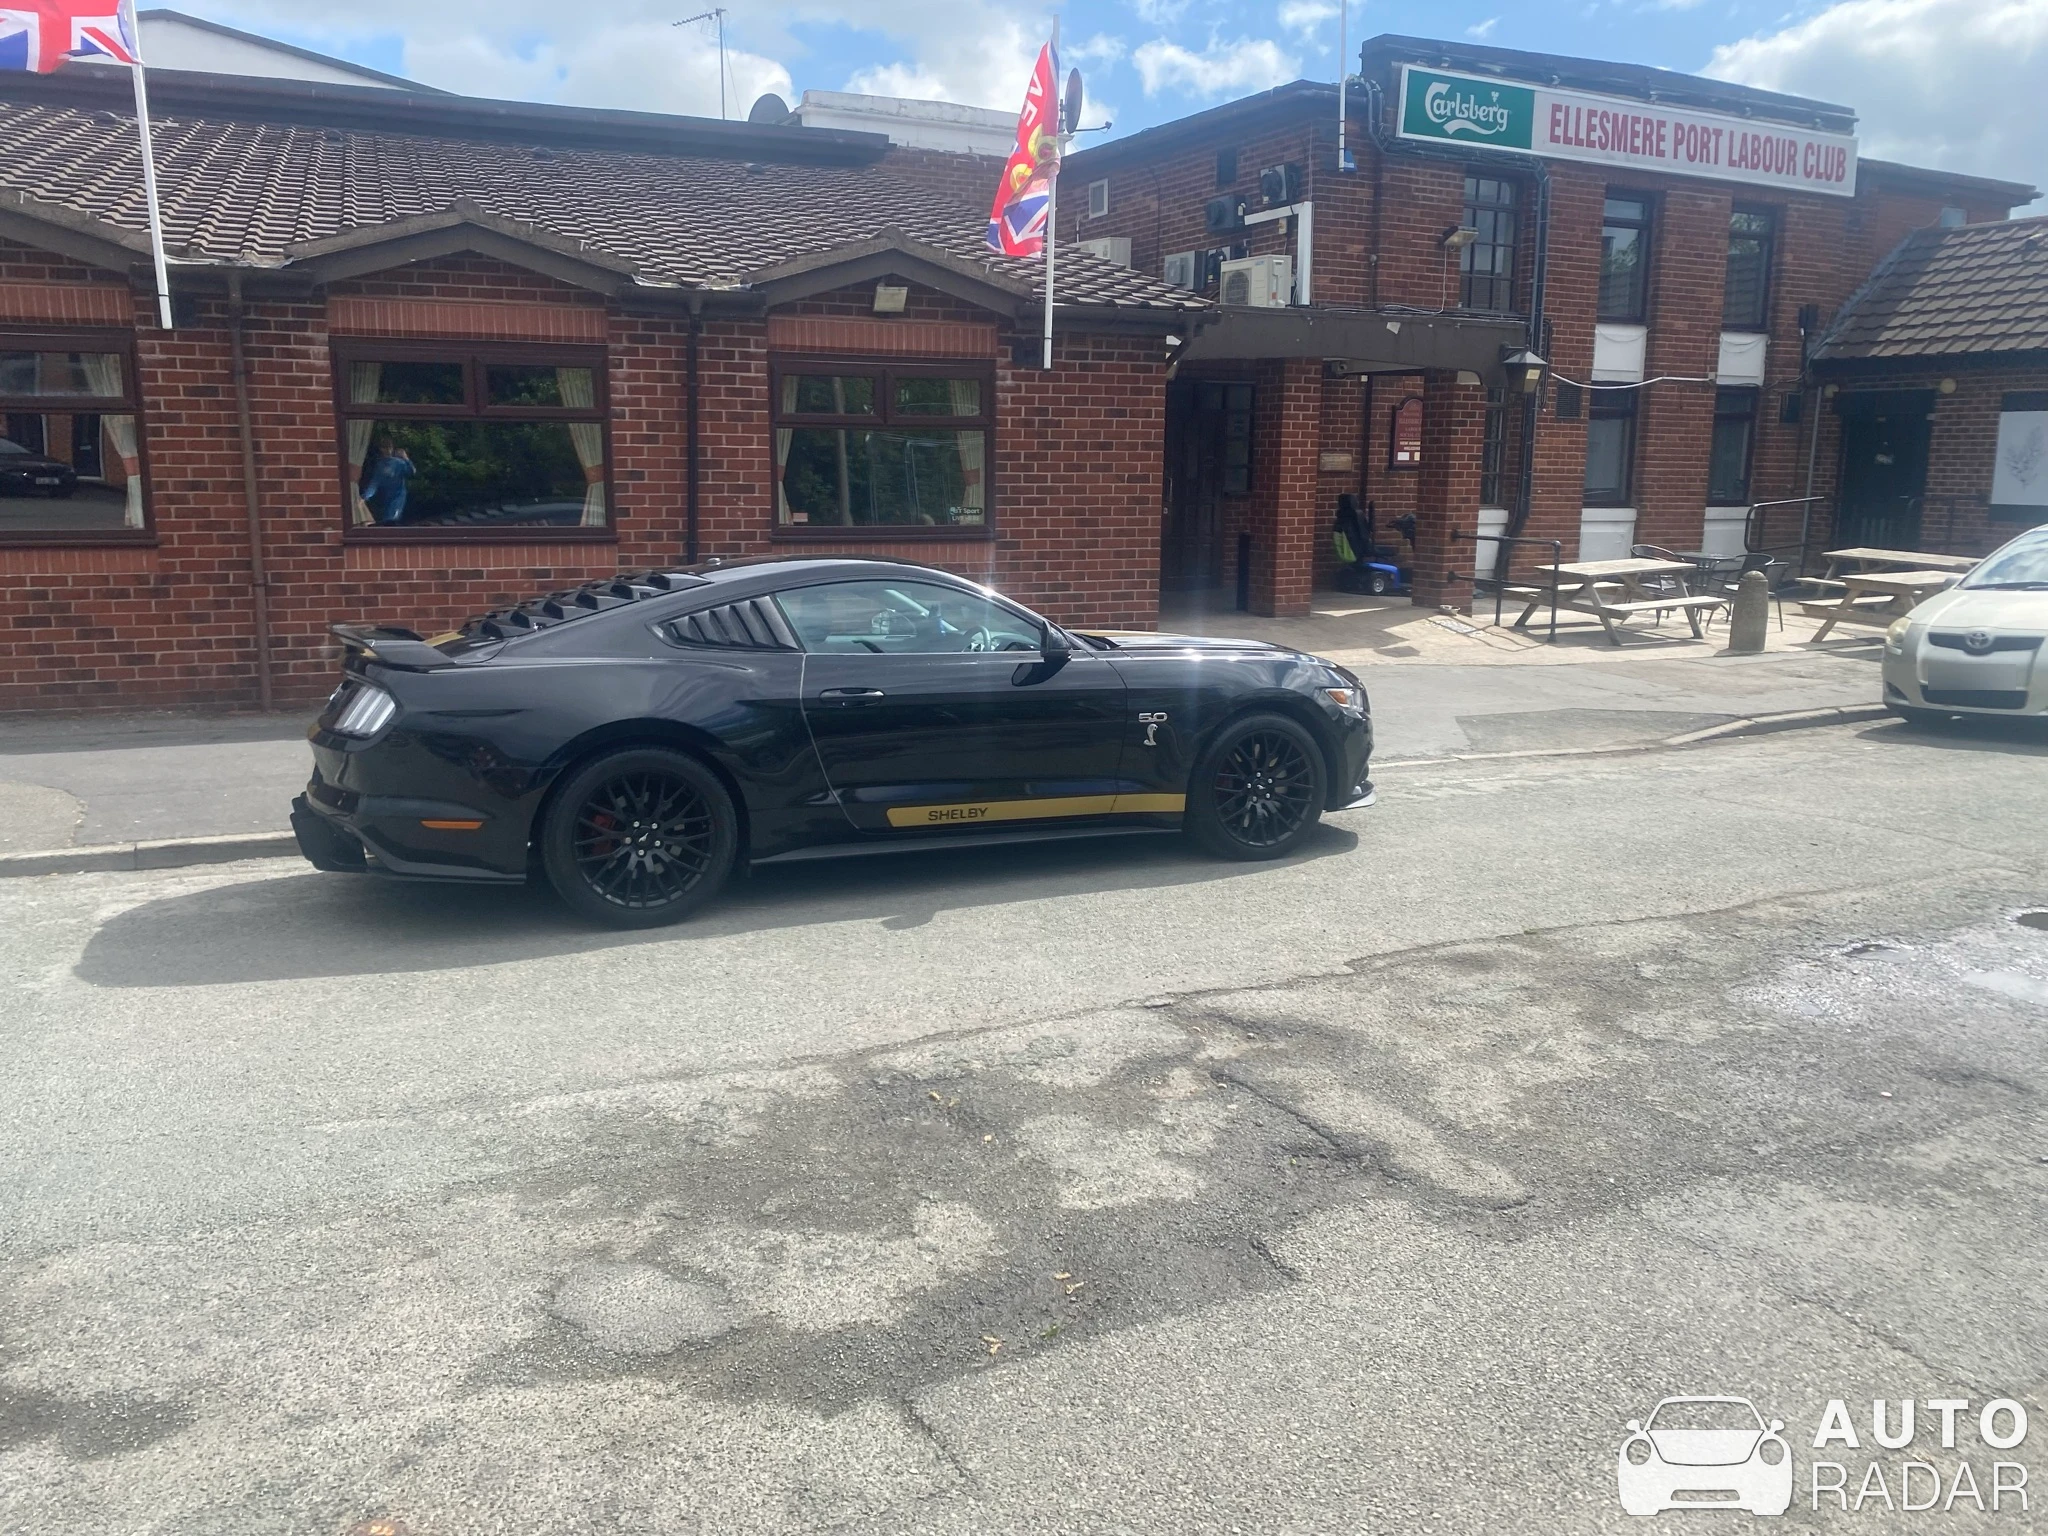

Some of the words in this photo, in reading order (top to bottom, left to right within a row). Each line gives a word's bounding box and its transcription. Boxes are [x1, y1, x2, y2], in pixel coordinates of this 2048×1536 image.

[1425, 82, 1509, 132] Carlsberg
[1550, 103, 1667, 158] ELLESMERE
[1673, 122, 1723, 165] PORT
[1728, 129, 1798, 176] LABOUR
[1803, 141, 1847, 182] CLUB
[928, 807, 988, 821] SHELBY
